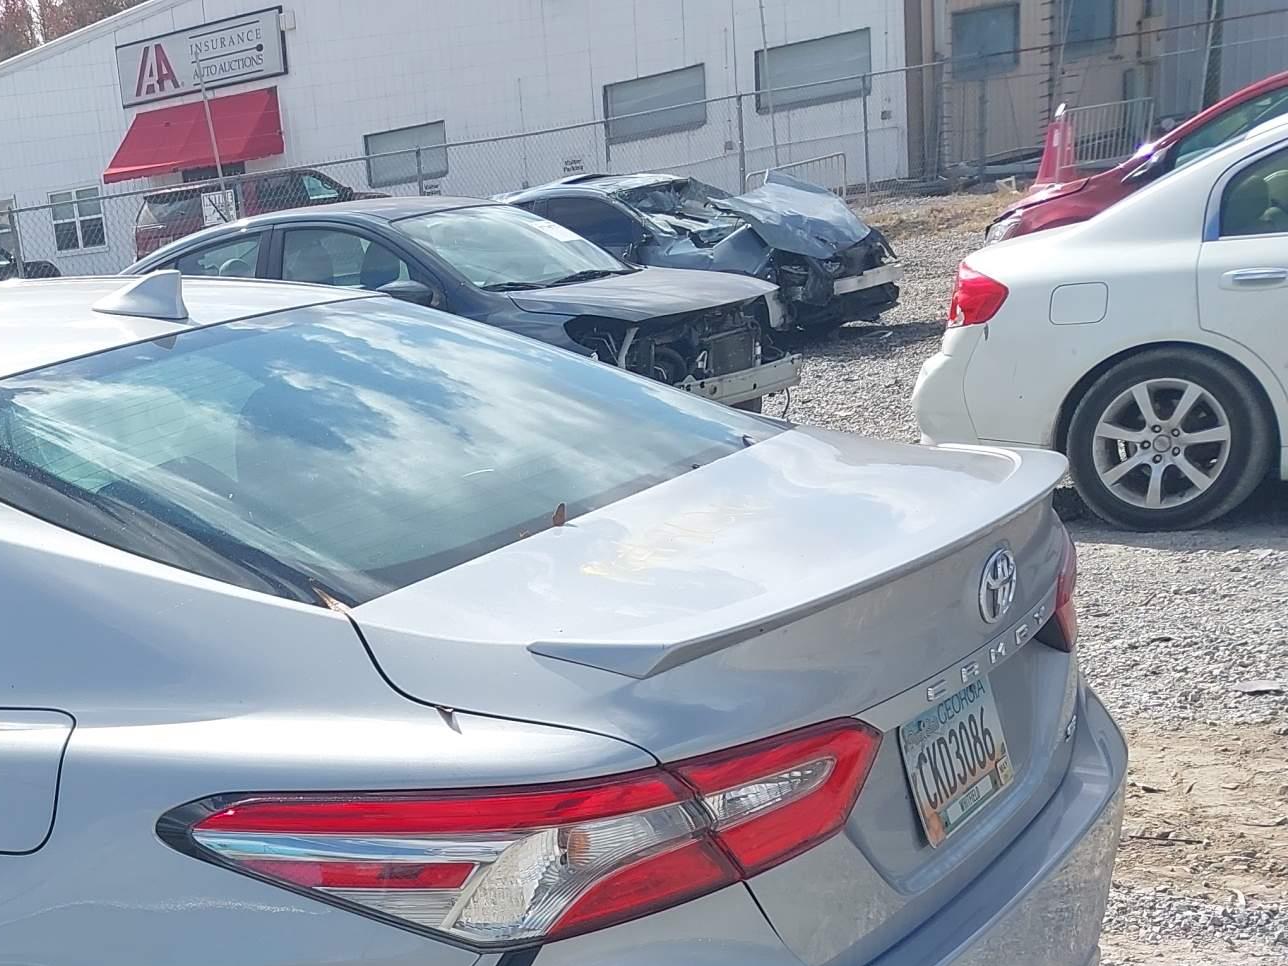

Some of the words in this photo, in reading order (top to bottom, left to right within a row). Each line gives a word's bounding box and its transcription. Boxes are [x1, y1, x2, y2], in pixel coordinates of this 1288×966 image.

[189, 27, 262, 56] INSURANCE
[193, 62, 218, 80] AUTO
[218, 54, 264, 74] AUCTIONS
[937, 680, 986, 725] GEORGIA
[916, 706, 996, 810] CKD3086
